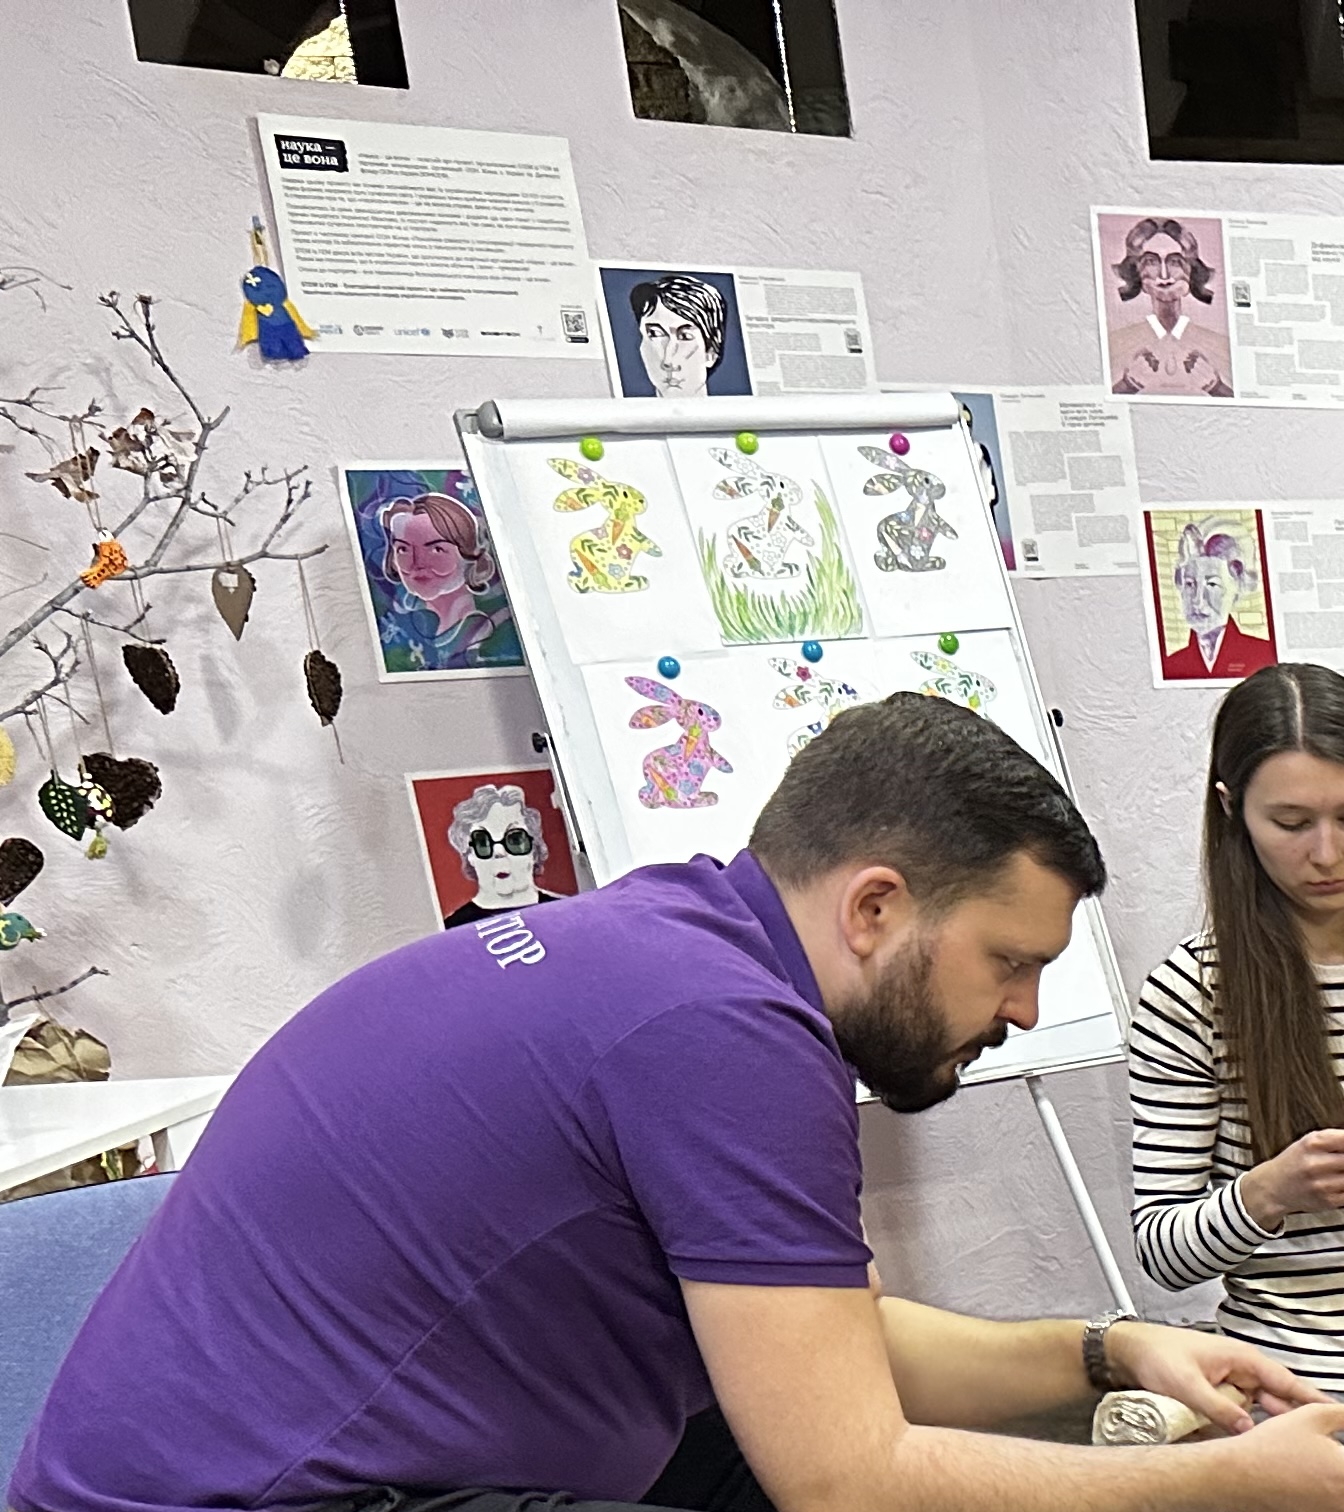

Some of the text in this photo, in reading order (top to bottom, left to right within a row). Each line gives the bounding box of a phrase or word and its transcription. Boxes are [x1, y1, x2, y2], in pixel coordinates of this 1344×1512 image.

[280, 140, 322, 153] наука
[282, 153, 339, 166] це вона
